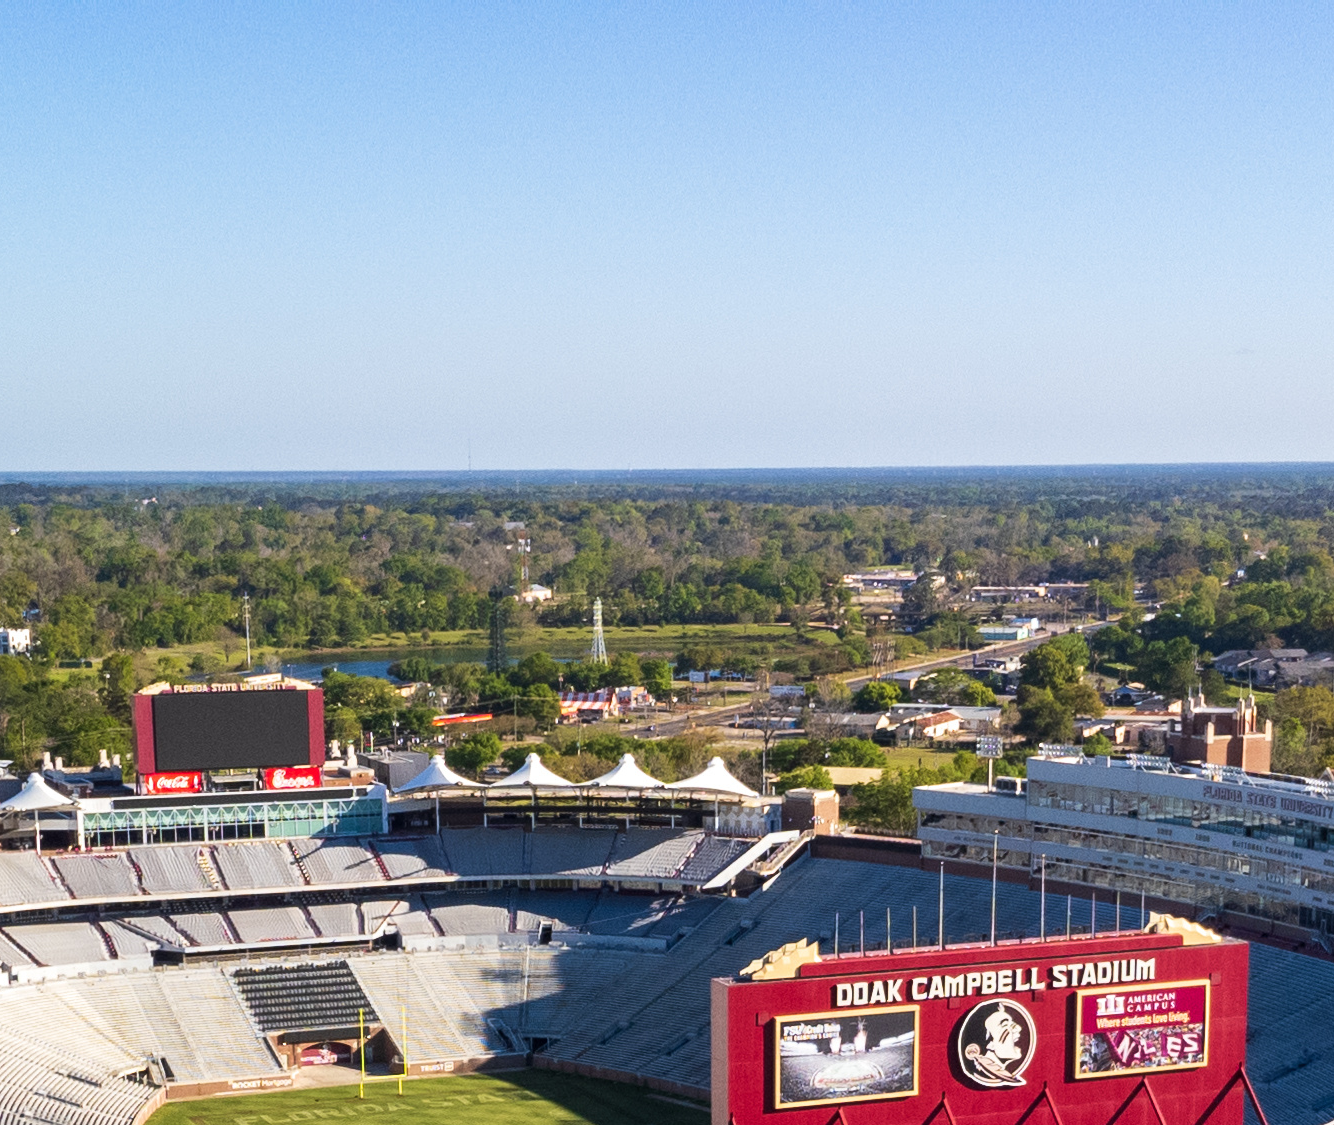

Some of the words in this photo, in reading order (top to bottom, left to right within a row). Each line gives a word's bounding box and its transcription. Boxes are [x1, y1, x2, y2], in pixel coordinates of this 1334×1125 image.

[173, 684, 208, 694] FLORIDA
[211, 683, 238, 692] STATE
[240, 681, 287, 691] UNIVERSITY
[1203, 786, 1242, 803] FLORIDA
[1247, 792, 1277, 809] STATE
[1281, 797, 1334, 819] UNIVERSITY
[836, 979, 903, 1007] DOAK
[910, 966, 1046, 1001] CAMPBELL
[1052, 957, 1156, 988] STADIUM
[1127, 992, 1177, 1004] AMERICAN
[1127, 1001, 1176, 1013] CAMPUS
[1096, 1017, 1121, 1029] Where
[1121, 1014, 1152, 1027] students
[1152, 1012, 1168, 1024] love
